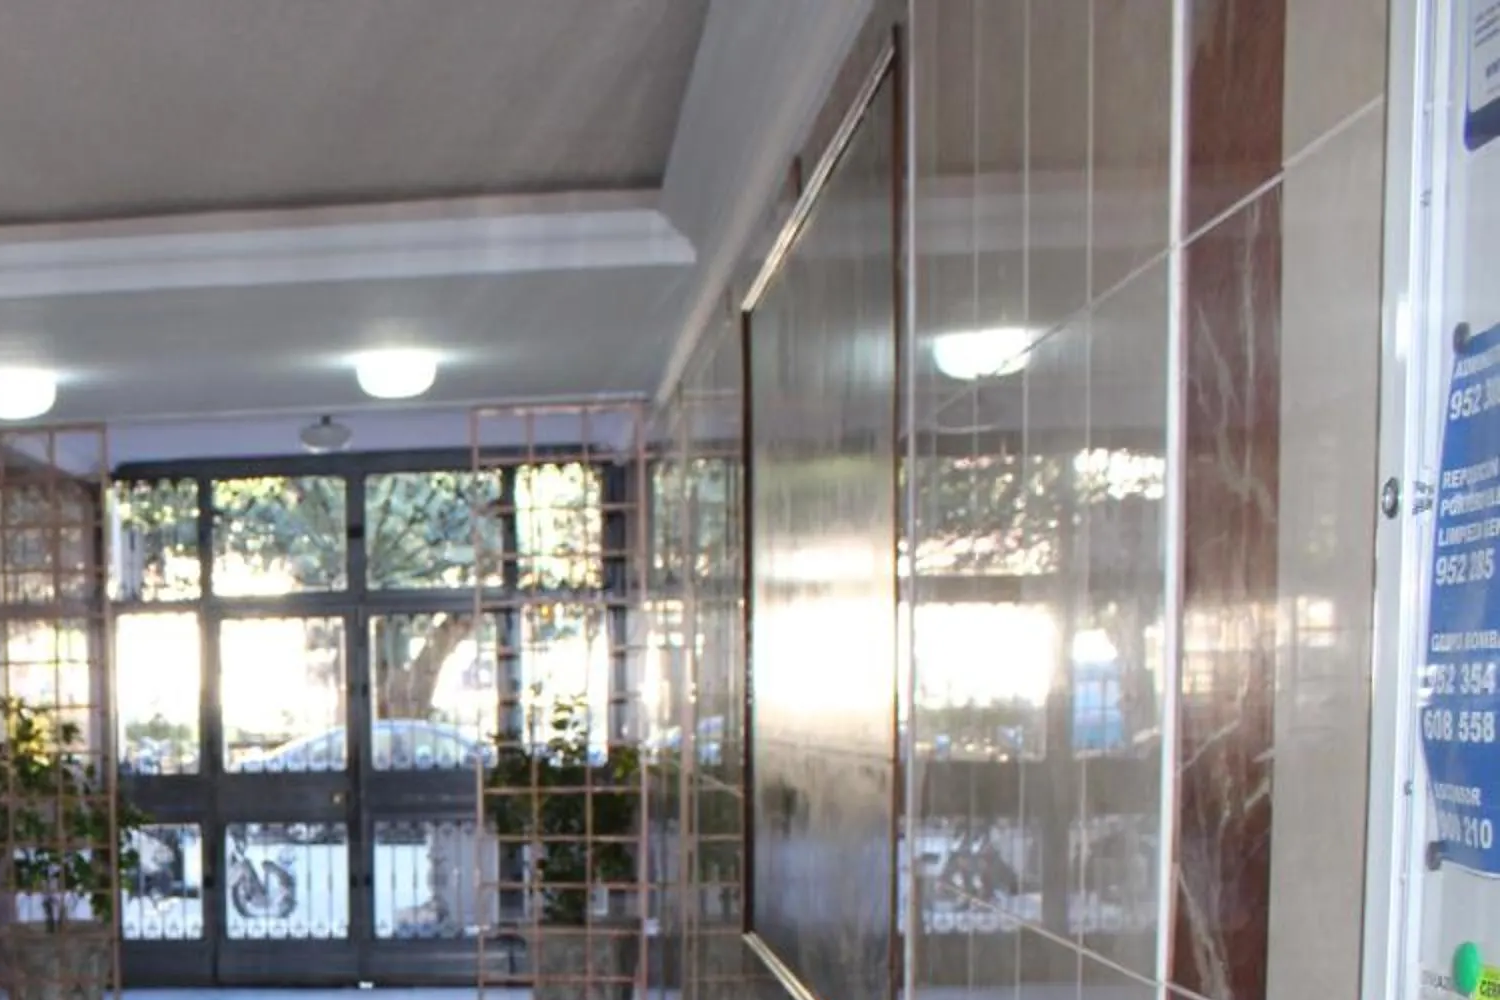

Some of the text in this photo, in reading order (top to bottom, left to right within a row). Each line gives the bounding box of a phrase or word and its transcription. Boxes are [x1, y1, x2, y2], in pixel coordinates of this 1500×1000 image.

[1449, 383, 1481, 420] 952
[1435, 554, 1466, 586] 952
[1460, 661, 1496, 695] 354
[1458, 710, 1495, 743] 558
